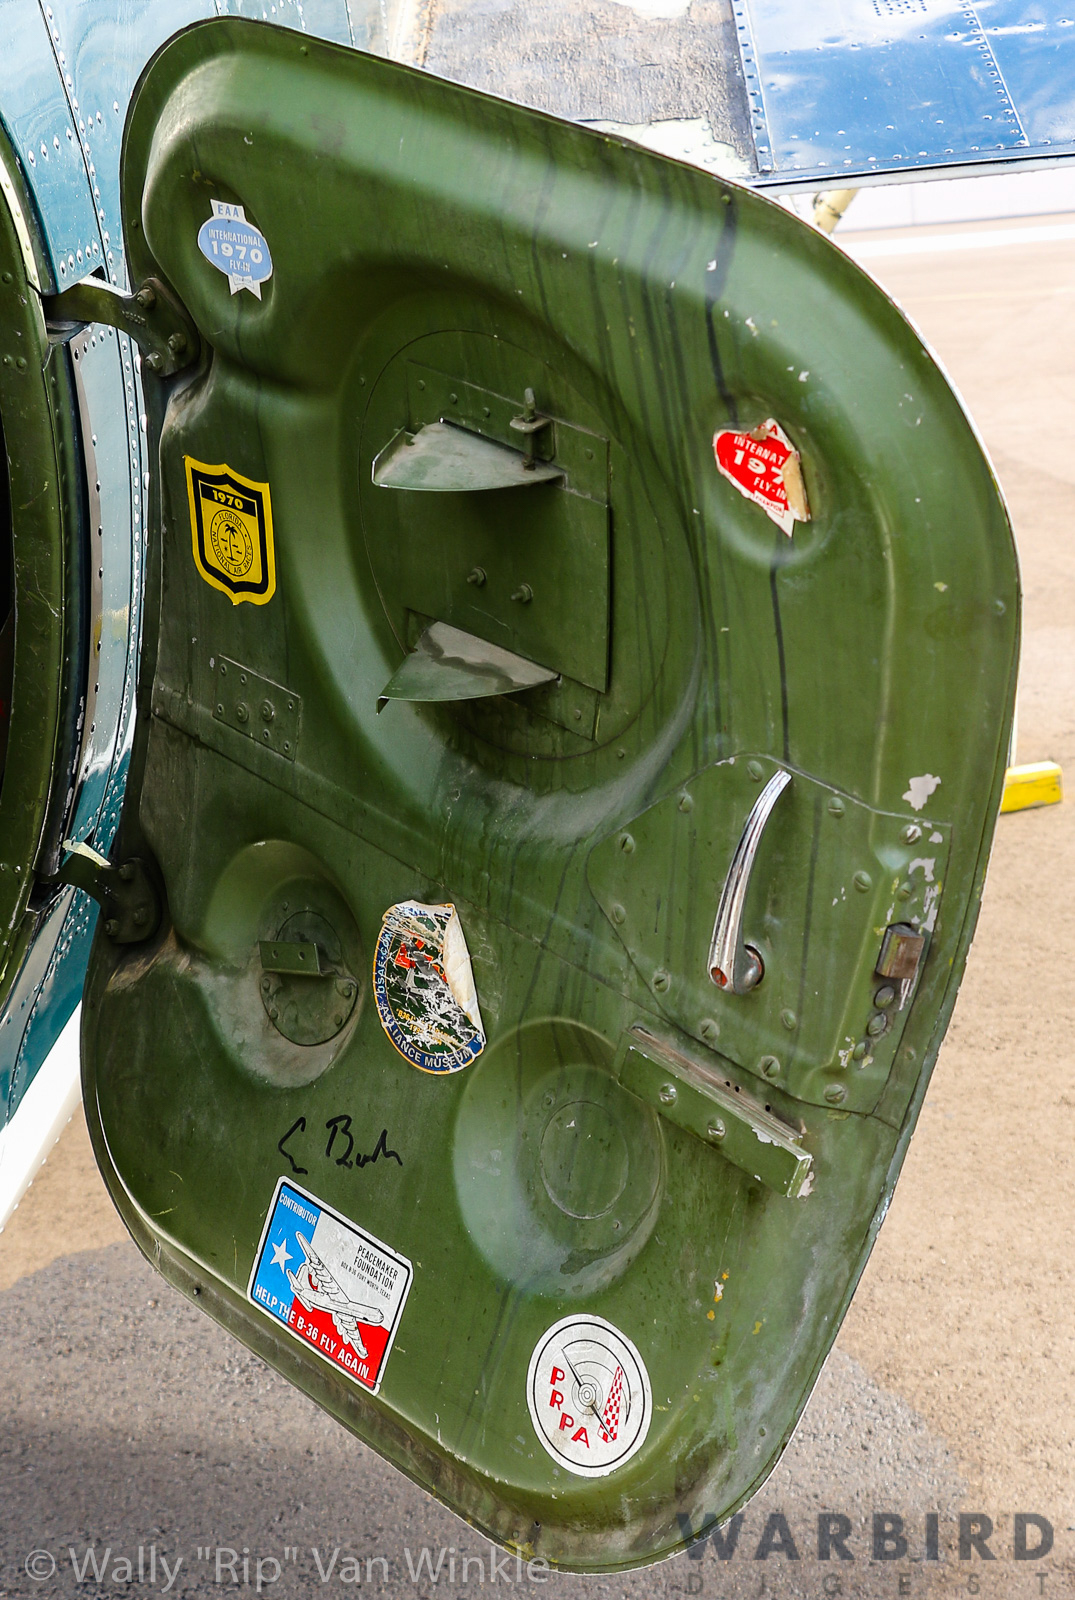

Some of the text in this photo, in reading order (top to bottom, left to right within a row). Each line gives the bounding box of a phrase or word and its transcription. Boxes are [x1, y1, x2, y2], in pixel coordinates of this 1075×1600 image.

[217, 204, 240, 218] EAA
[208, 228, 262, 248] INTERNATIONAL
[211, 240, 263, 264] 1970
[229, 259, 251, 273] FLY-IN
[733, 435, 785, 466] INTERNAT
[733, 449, 784, 485] 197
[212, 489, 244, 510] 1970
[753, 477, 788, 501] FLY-IN
[218, 512, 242, 529] FLORIDA
[211, 530, 230, 572] NATIONAL
[233, 566, 243, 574] AIR
[424, 1048, 472, 1068] MUSEUM
[279, 1192, 318, 1227] CONTRIBUTOR
[353, 1255, 395, 1291] FOUNDATION
[357, 1244, 399, 1281] PEACEMAKER
[255, 1284, 370, 1381] HELP THE B-36 FLY AGAIN
